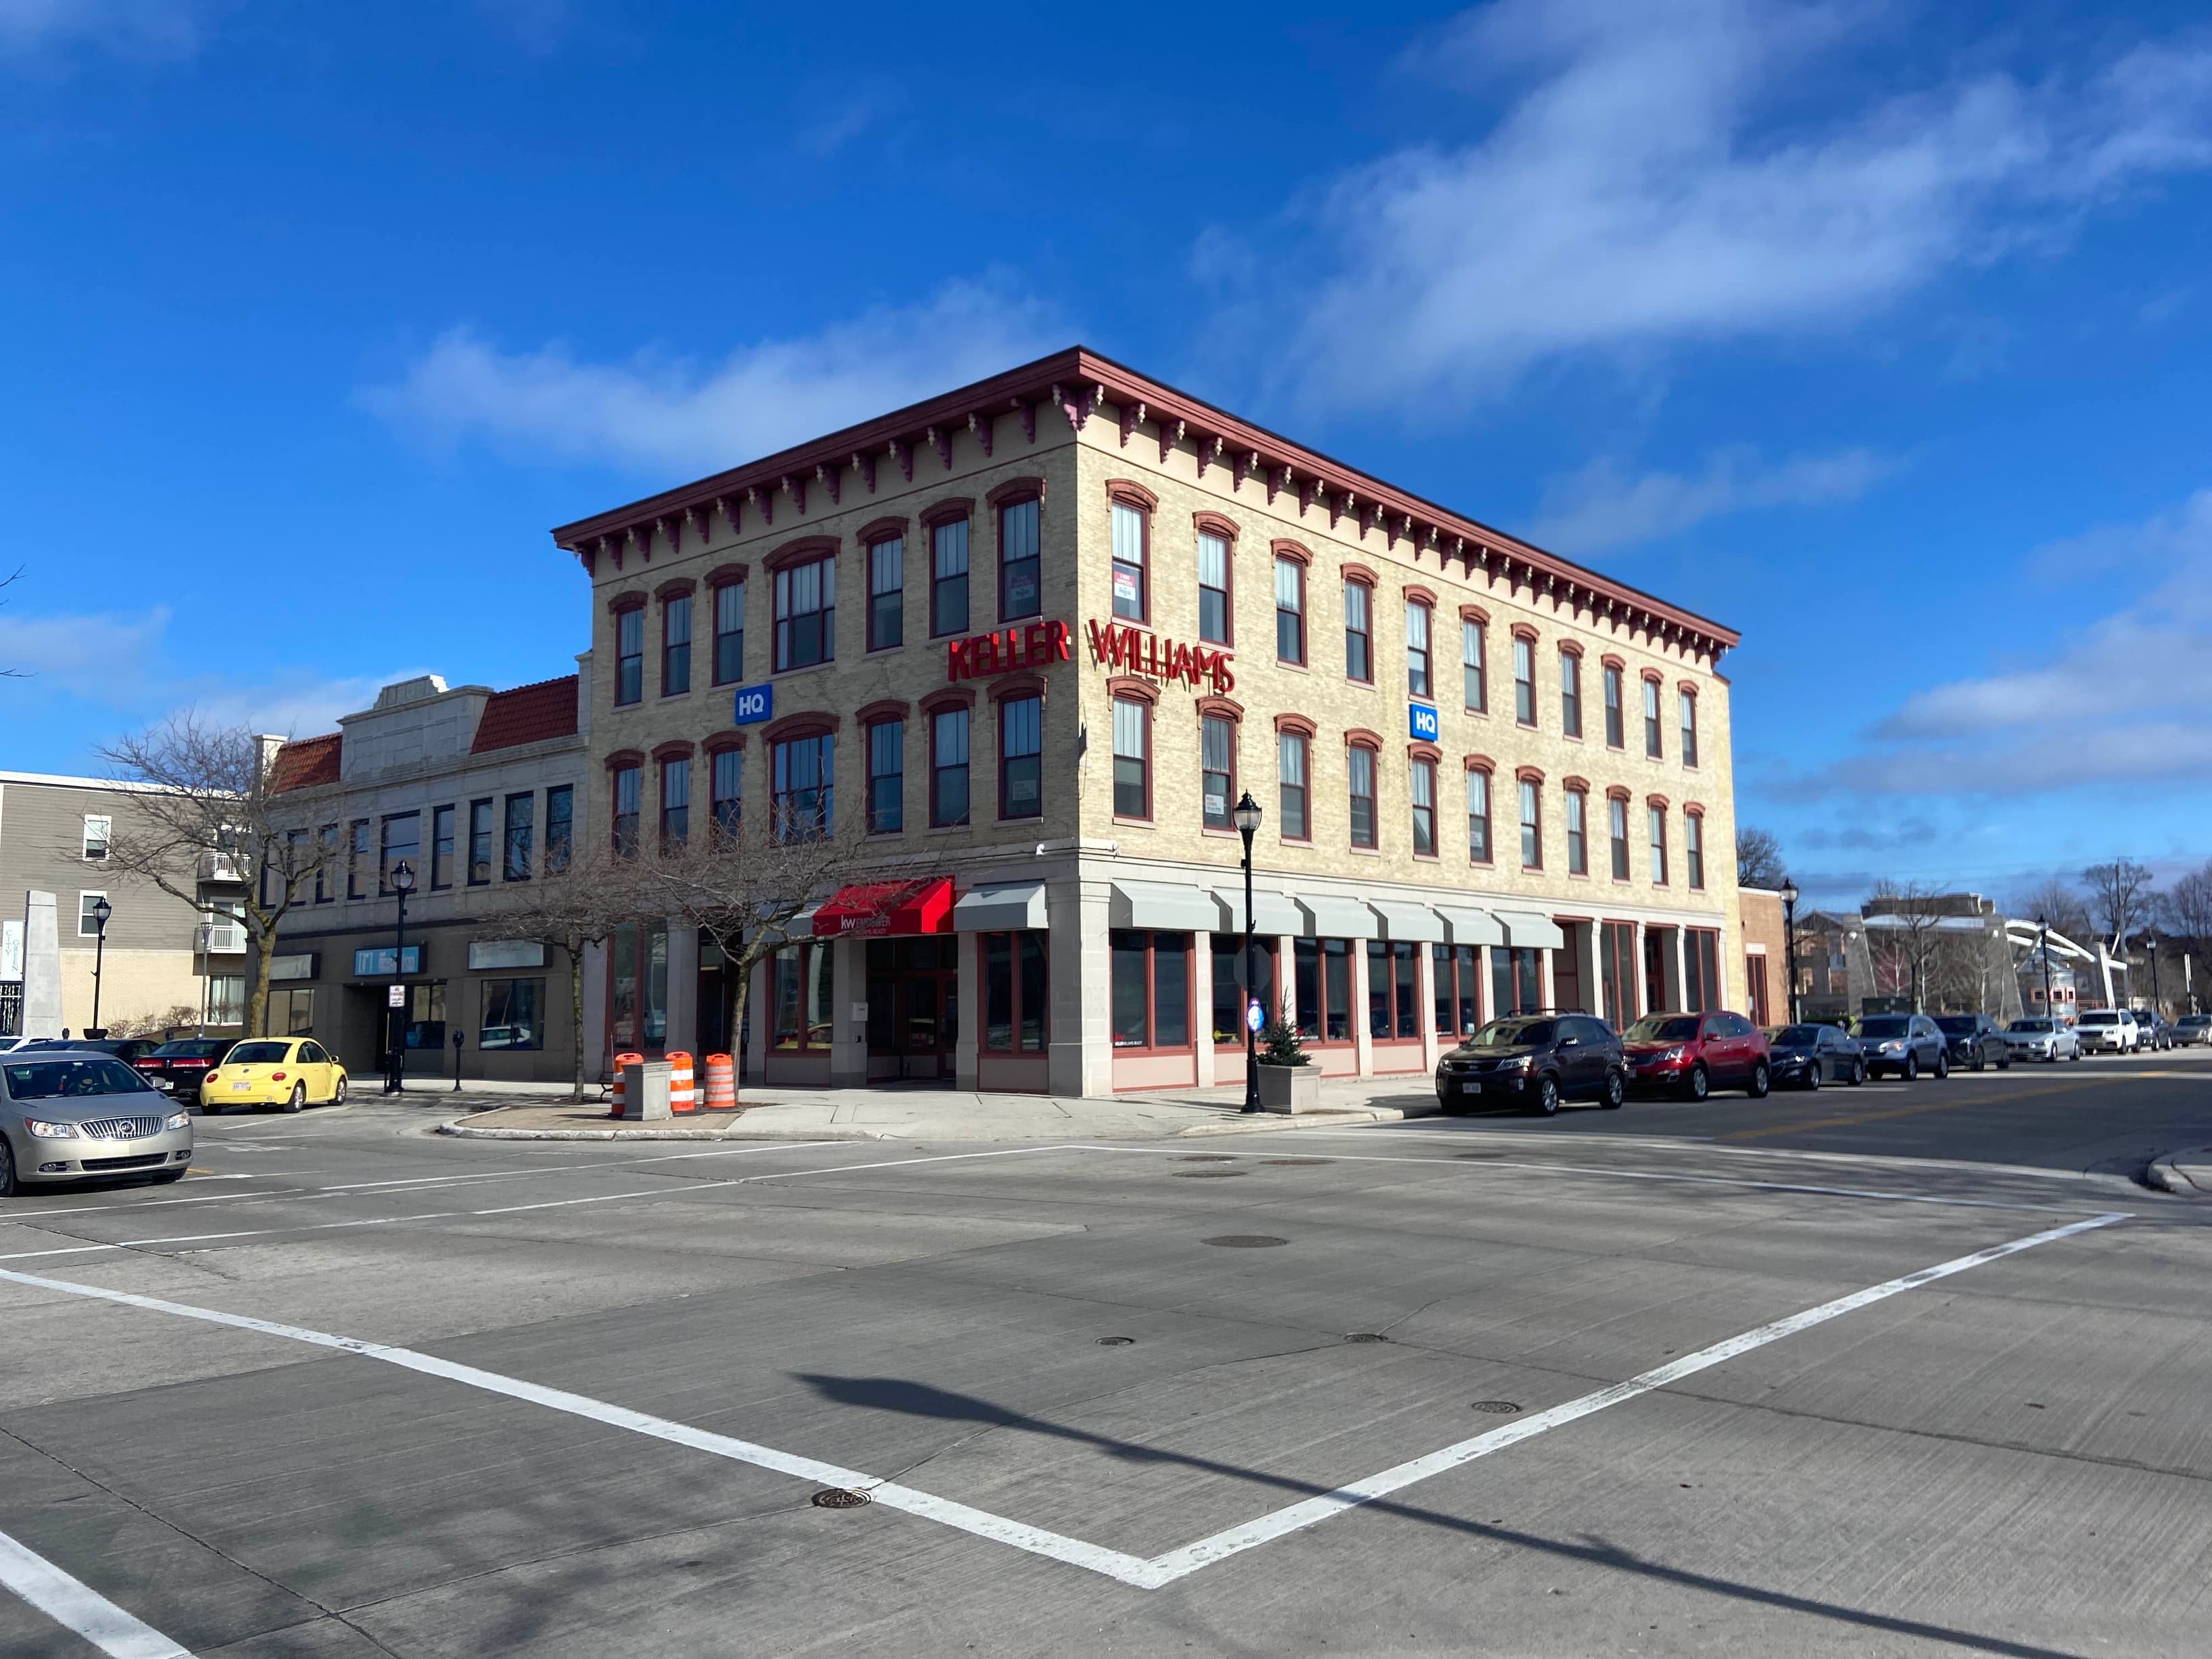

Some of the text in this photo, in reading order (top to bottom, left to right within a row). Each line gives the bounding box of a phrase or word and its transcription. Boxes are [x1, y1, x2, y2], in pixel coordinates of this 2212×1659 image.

[948, 619, 1235, 692] KELLER WILLIAMS
[739, 694, 764, 716] HQ
[1416, 711, 1435, 734] HQ
[841, 915, 856, 930] kw
[11, 940, 20, 972] GREEN
